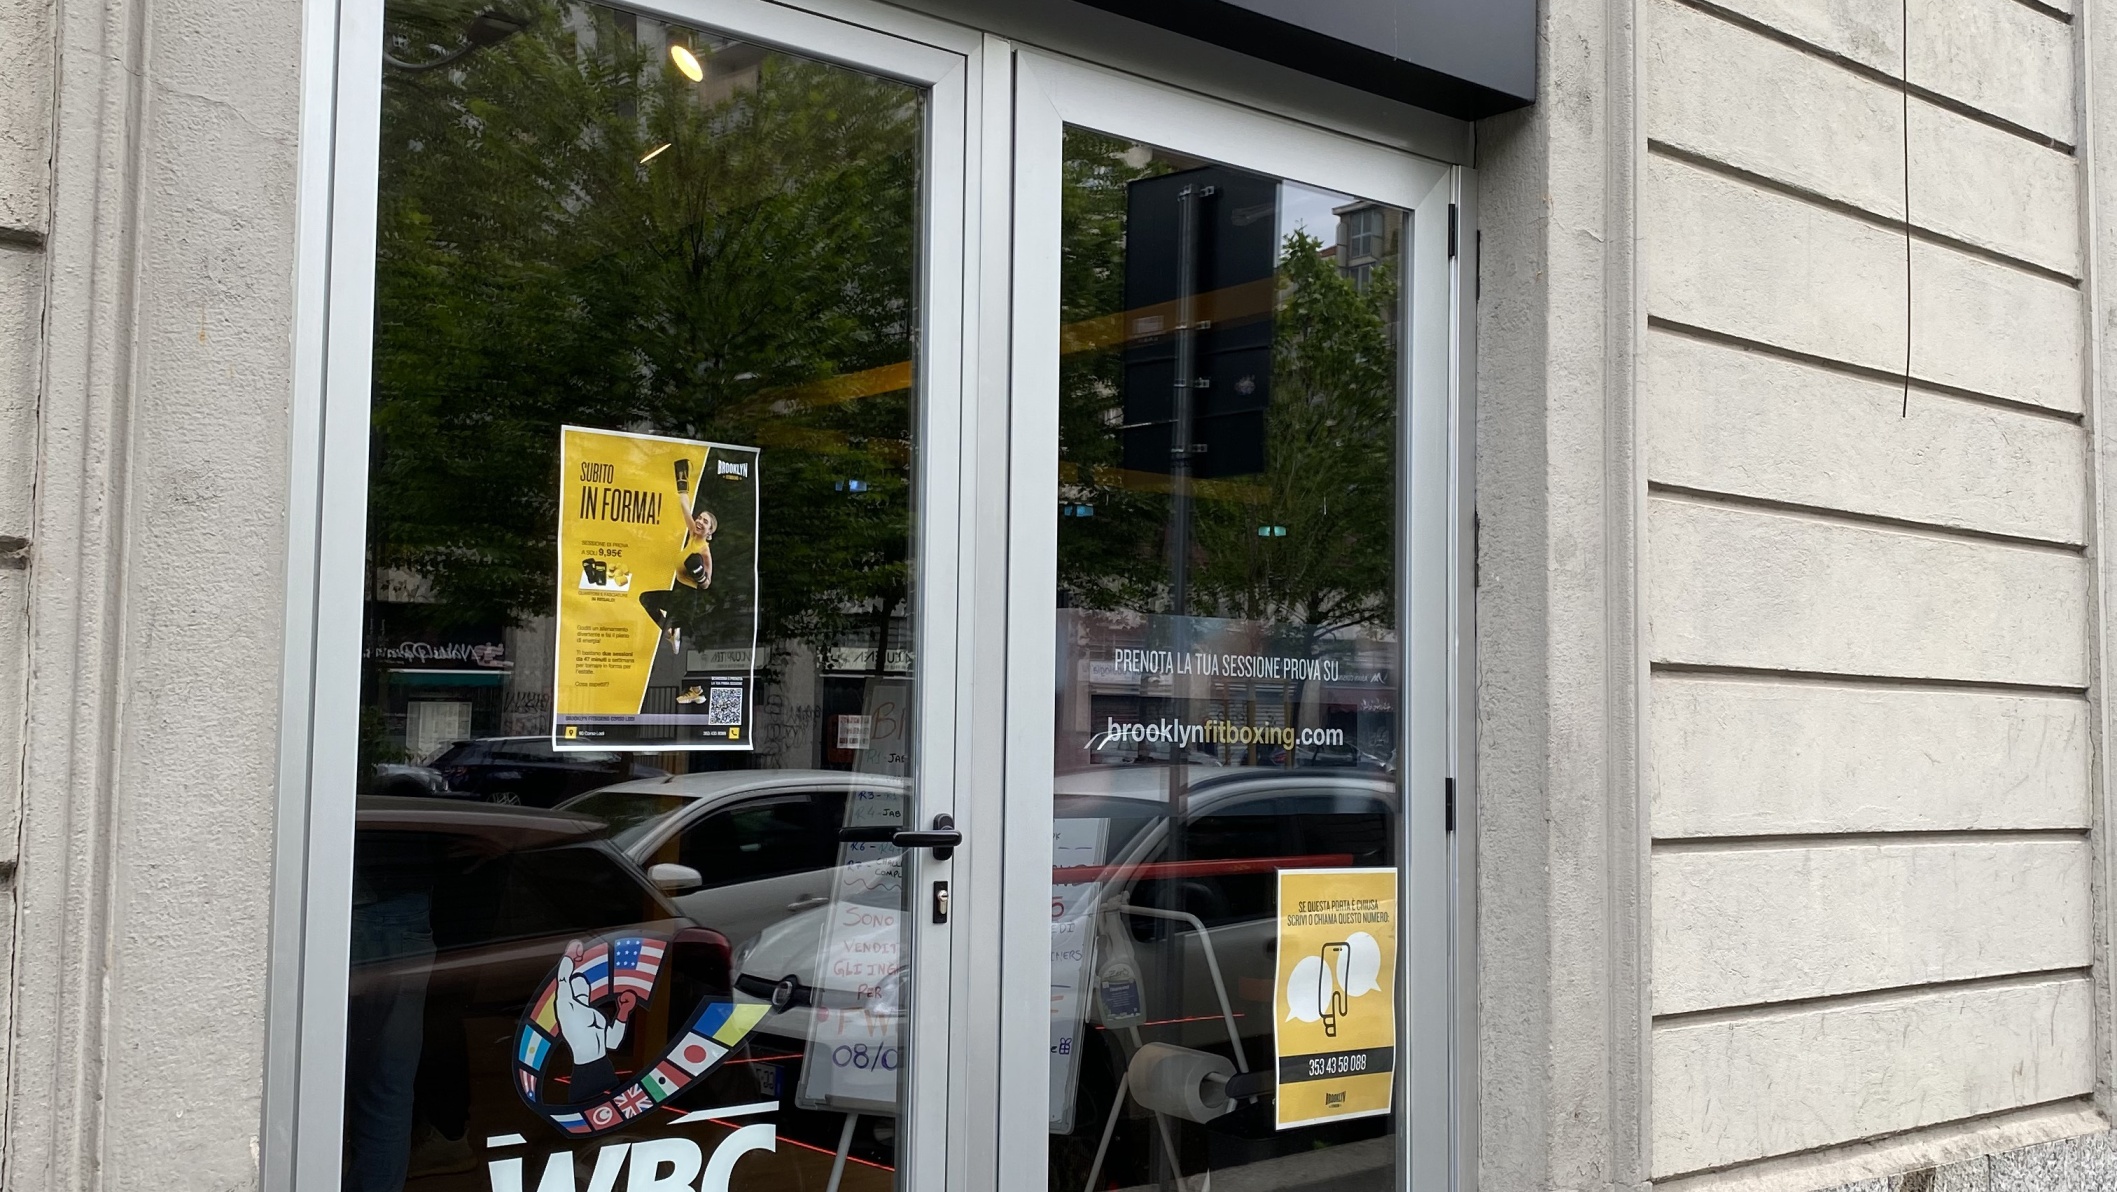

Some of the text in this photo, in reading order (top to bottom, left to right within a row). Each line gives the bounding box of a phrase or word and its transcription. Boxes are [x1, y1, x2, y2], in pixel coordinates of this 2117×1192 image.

[580, 461, 614, 484] SUBITO
[717, 459, 748, 478] BROOKLYN
[580, 486, 662, 525] IN FORMA!
[599, 548, 622, 557] 9,95€
[1115, 649, 1339, 681] PRENOTA LA TUA SESSIONE PROVA SU
[1107, 717, 1343, 750] brooklynfitboxing.com
[882, 808, 901, 818] JAB
[1298, 901, 1306, 913] SE
[1308, 900, 1330, 912] QUESTA
[843, 907, 894, 928] SONO
[1287, 914, 1308, 926] SCRIVI
[1308, 914, 1313, 926] O
[1314, 913, 1337, 925] CHIAMA
[1338, 912, 1361, 924] QUESTO
[857, 983, 882, 1000] PER
[1309, 1054, 1367, 1076] 353 43 58 088
